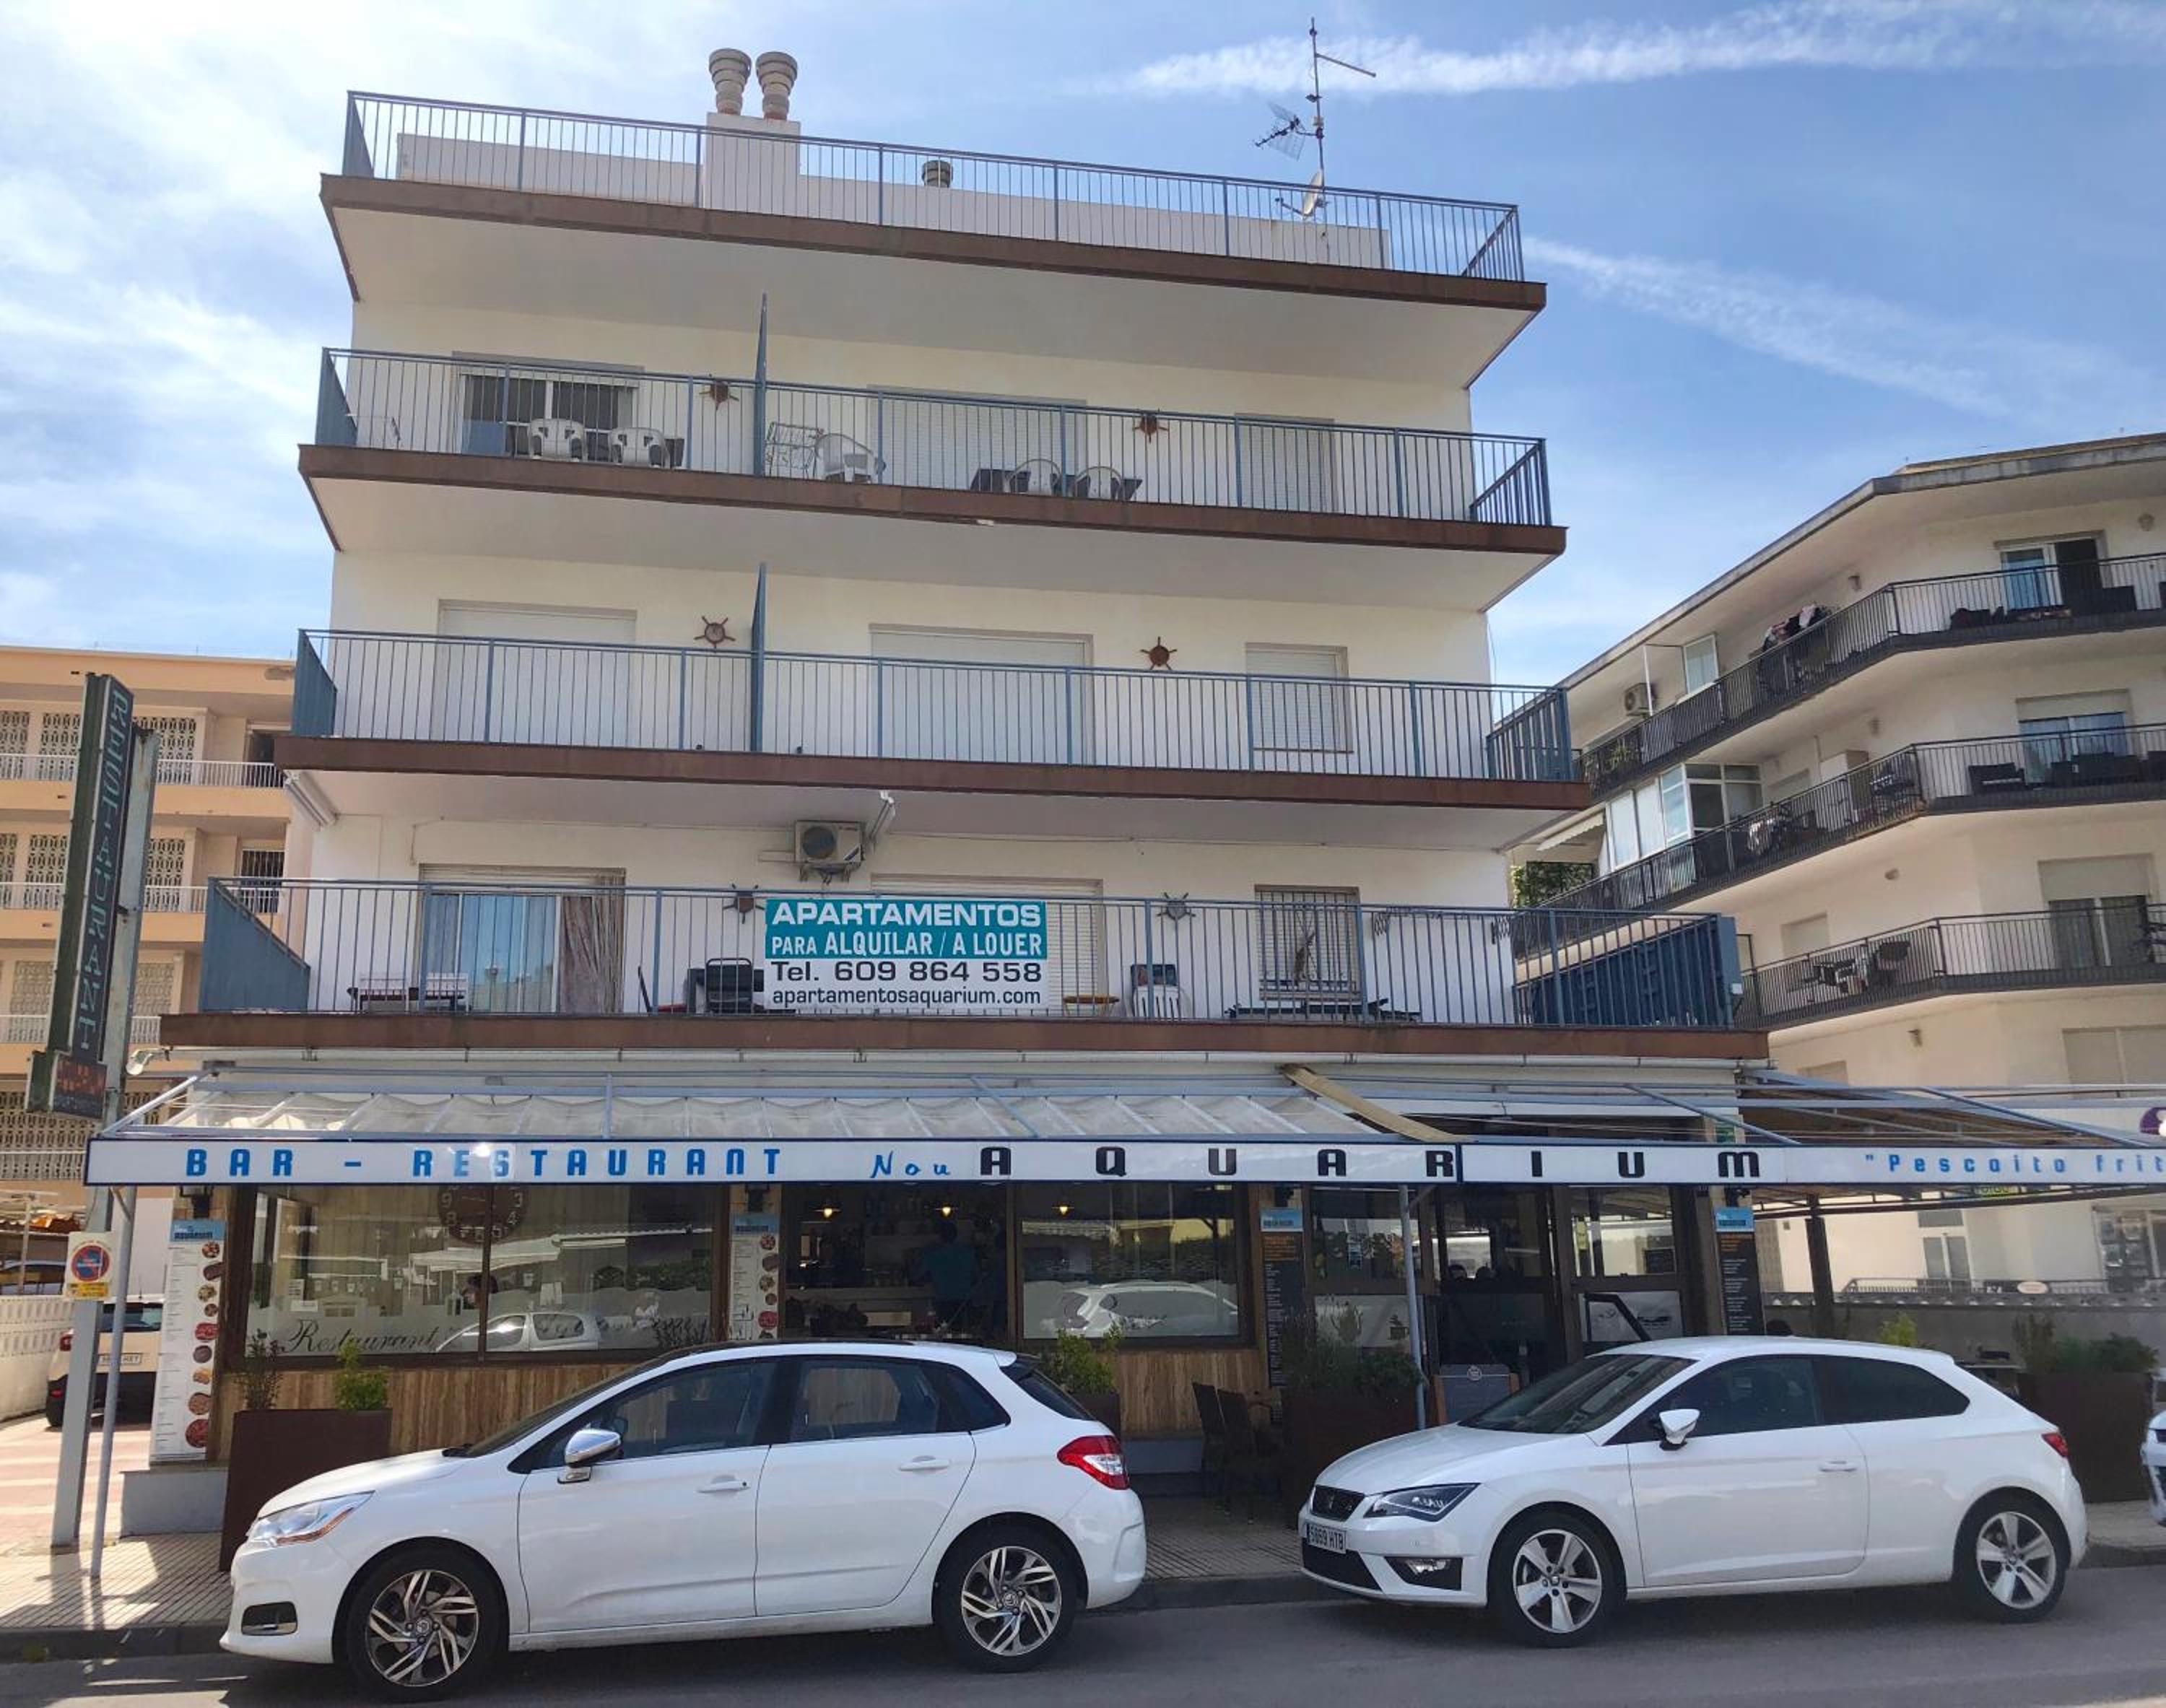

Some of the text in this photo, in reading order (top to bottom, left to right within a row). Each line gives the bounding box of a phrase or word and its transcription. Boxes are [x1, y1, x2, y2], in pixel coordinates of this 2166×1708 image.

[79, 689, 129, 1049] RESTAURANT
[772, 902, 1041, 927] APARTAMENTOS
[772, 931, 1042, 957] PARA ALQUILAR / A LOUER
[772, 961, 1042, 982] Tel. 609 864 558
[773, 986, 1040, 1008] apartamentosaquarium.com
[186, 1149, 292, 1177] BAR
[412, 1149, 780, 1177] RESTAURANT
[870, 1151, 951, 1179] Nou
[980, 1146, 1760, 1177] AQUARIUM
